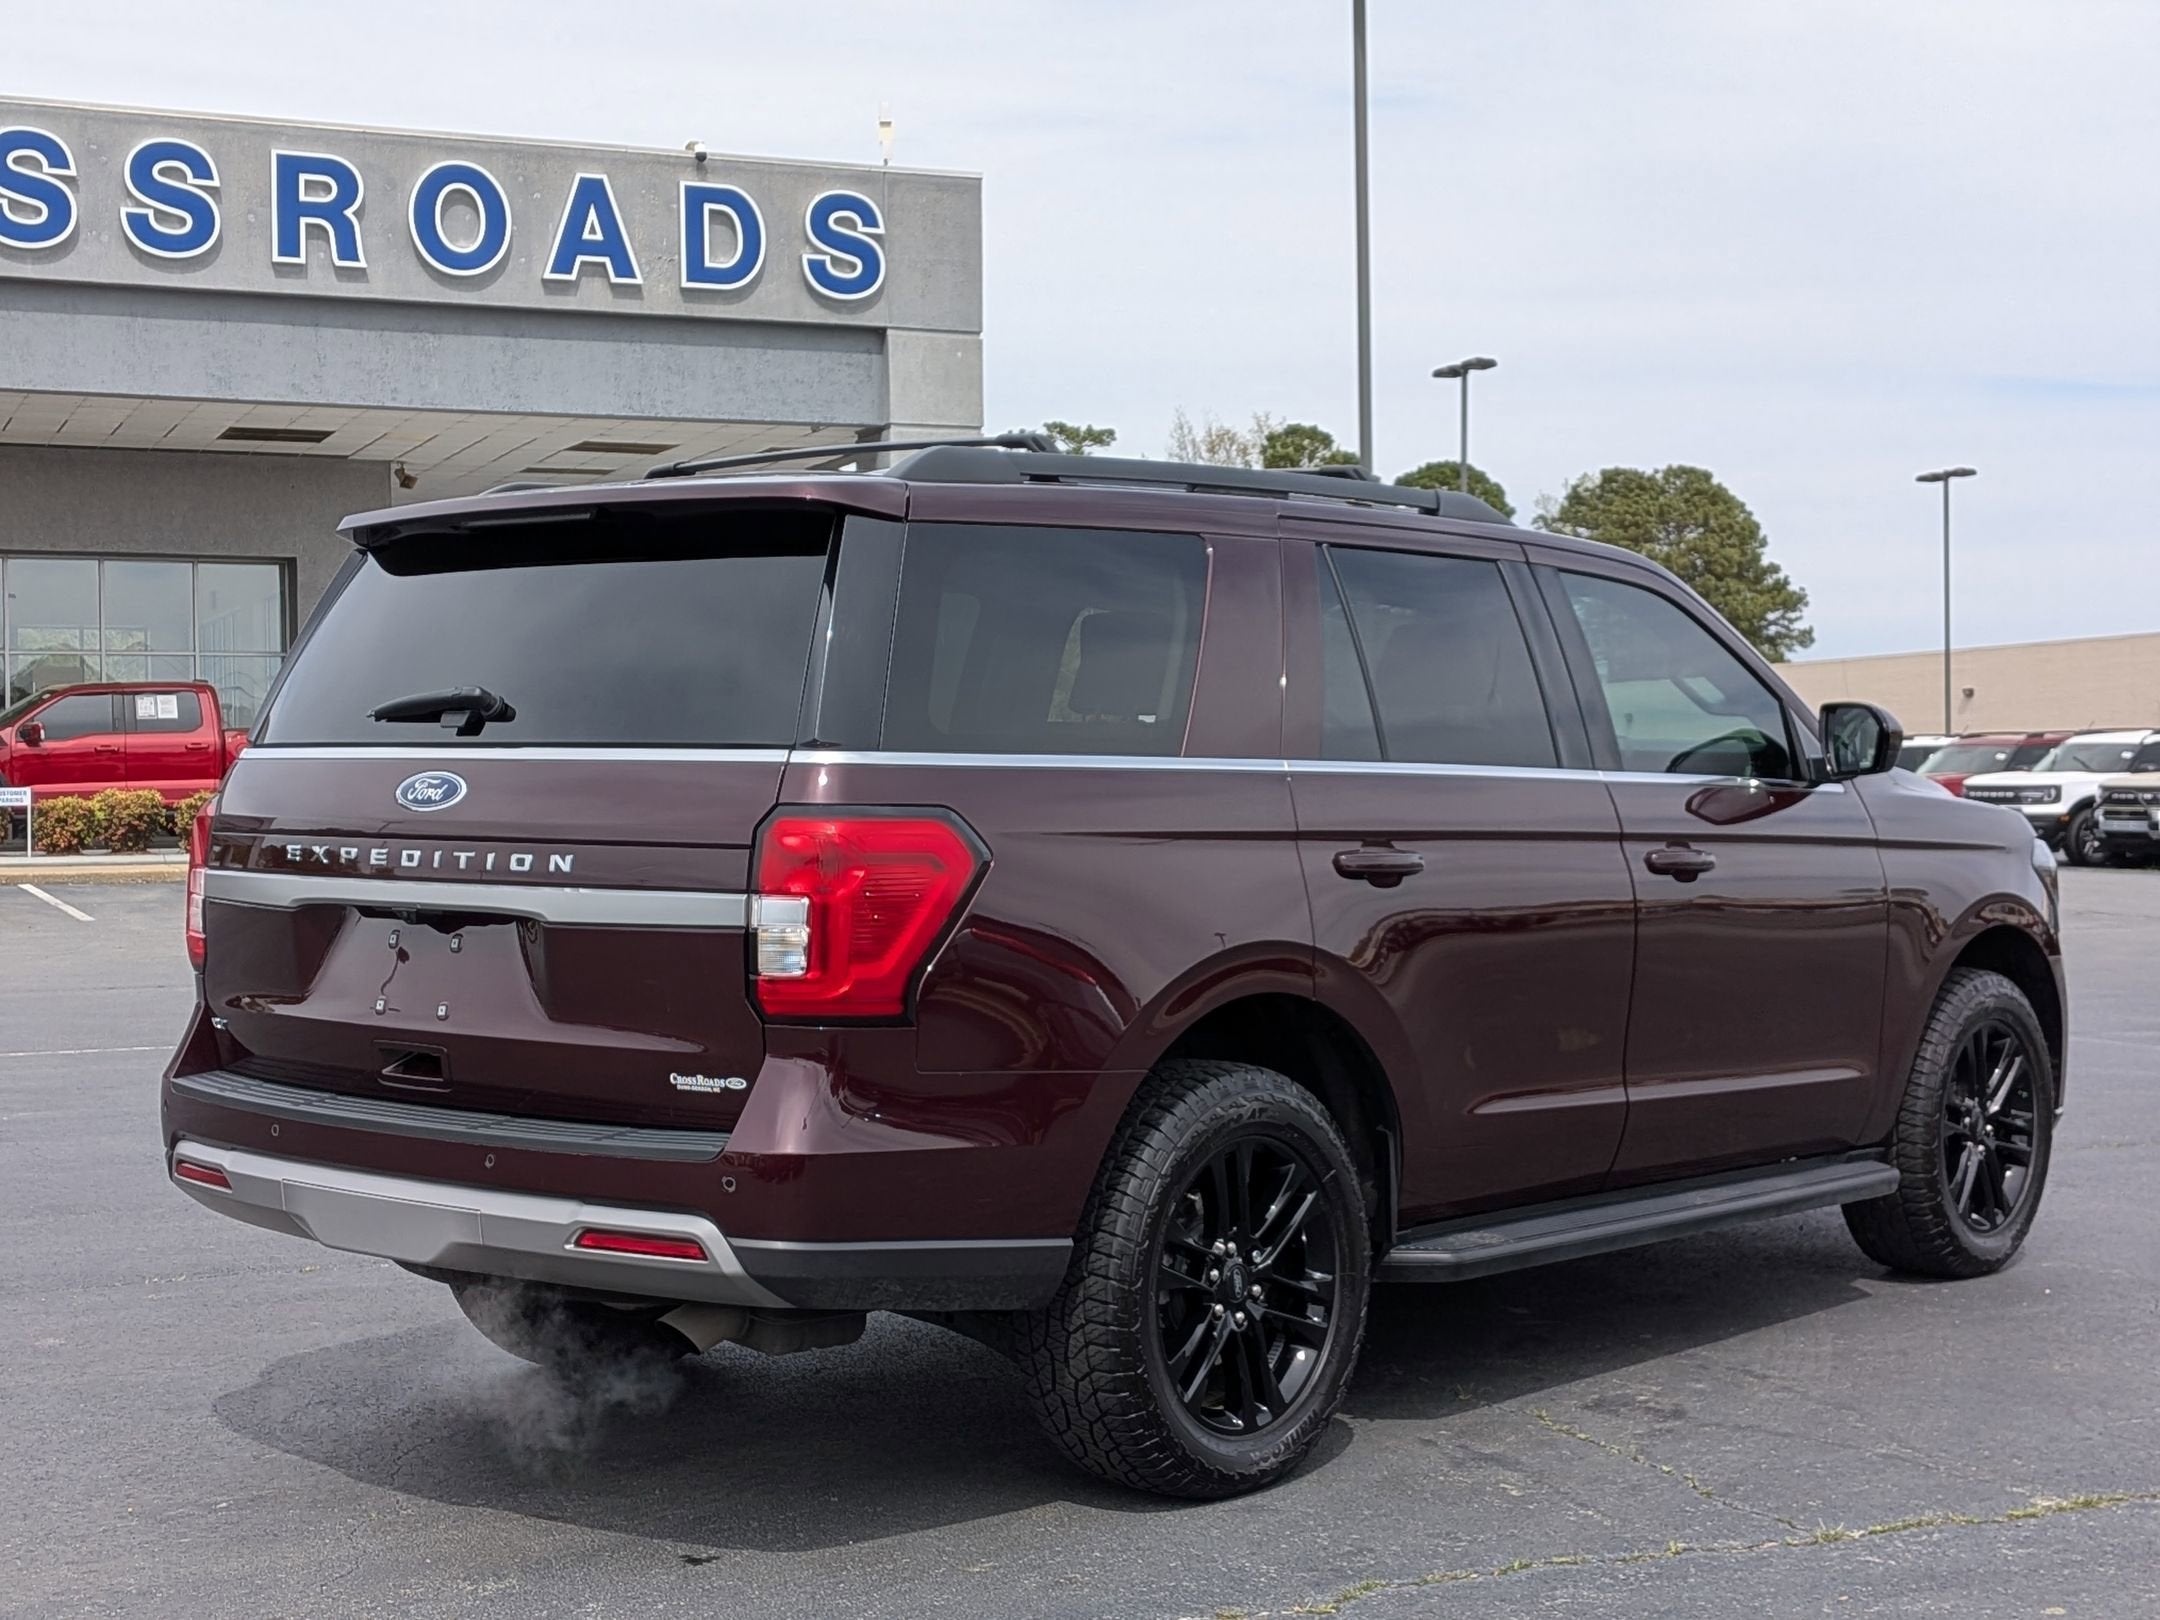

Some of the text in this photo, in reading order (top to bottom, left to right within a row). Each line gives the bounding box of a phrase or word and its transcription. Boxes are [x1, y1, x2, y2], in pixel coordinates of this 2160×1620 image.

[0, 126, 886, 300] SSROADS
[407, 777, 445, 801] Ford
[286, 844, 574, 873] EXPEDITION
